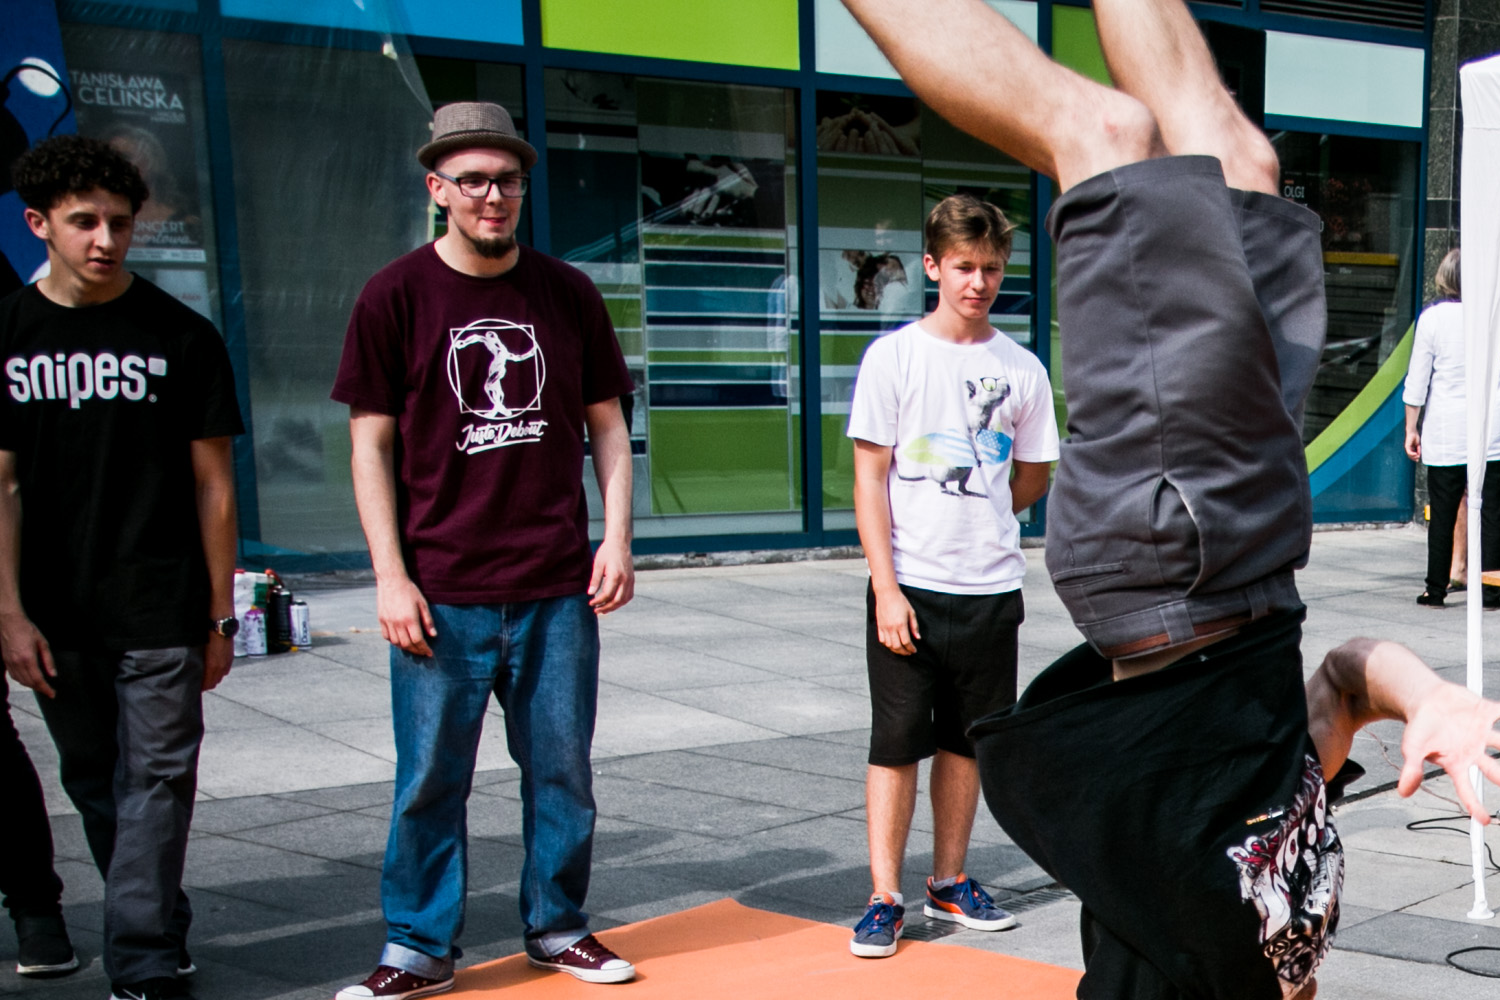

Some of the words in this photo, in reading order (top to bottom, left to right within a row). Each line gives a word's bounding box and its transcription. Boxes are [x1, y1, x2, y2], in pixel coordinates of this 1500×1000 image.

[5, 352, 147, 409] snipes
[456, 423, 495, 451] Juste
[493, 420, 549, 444] Debout
